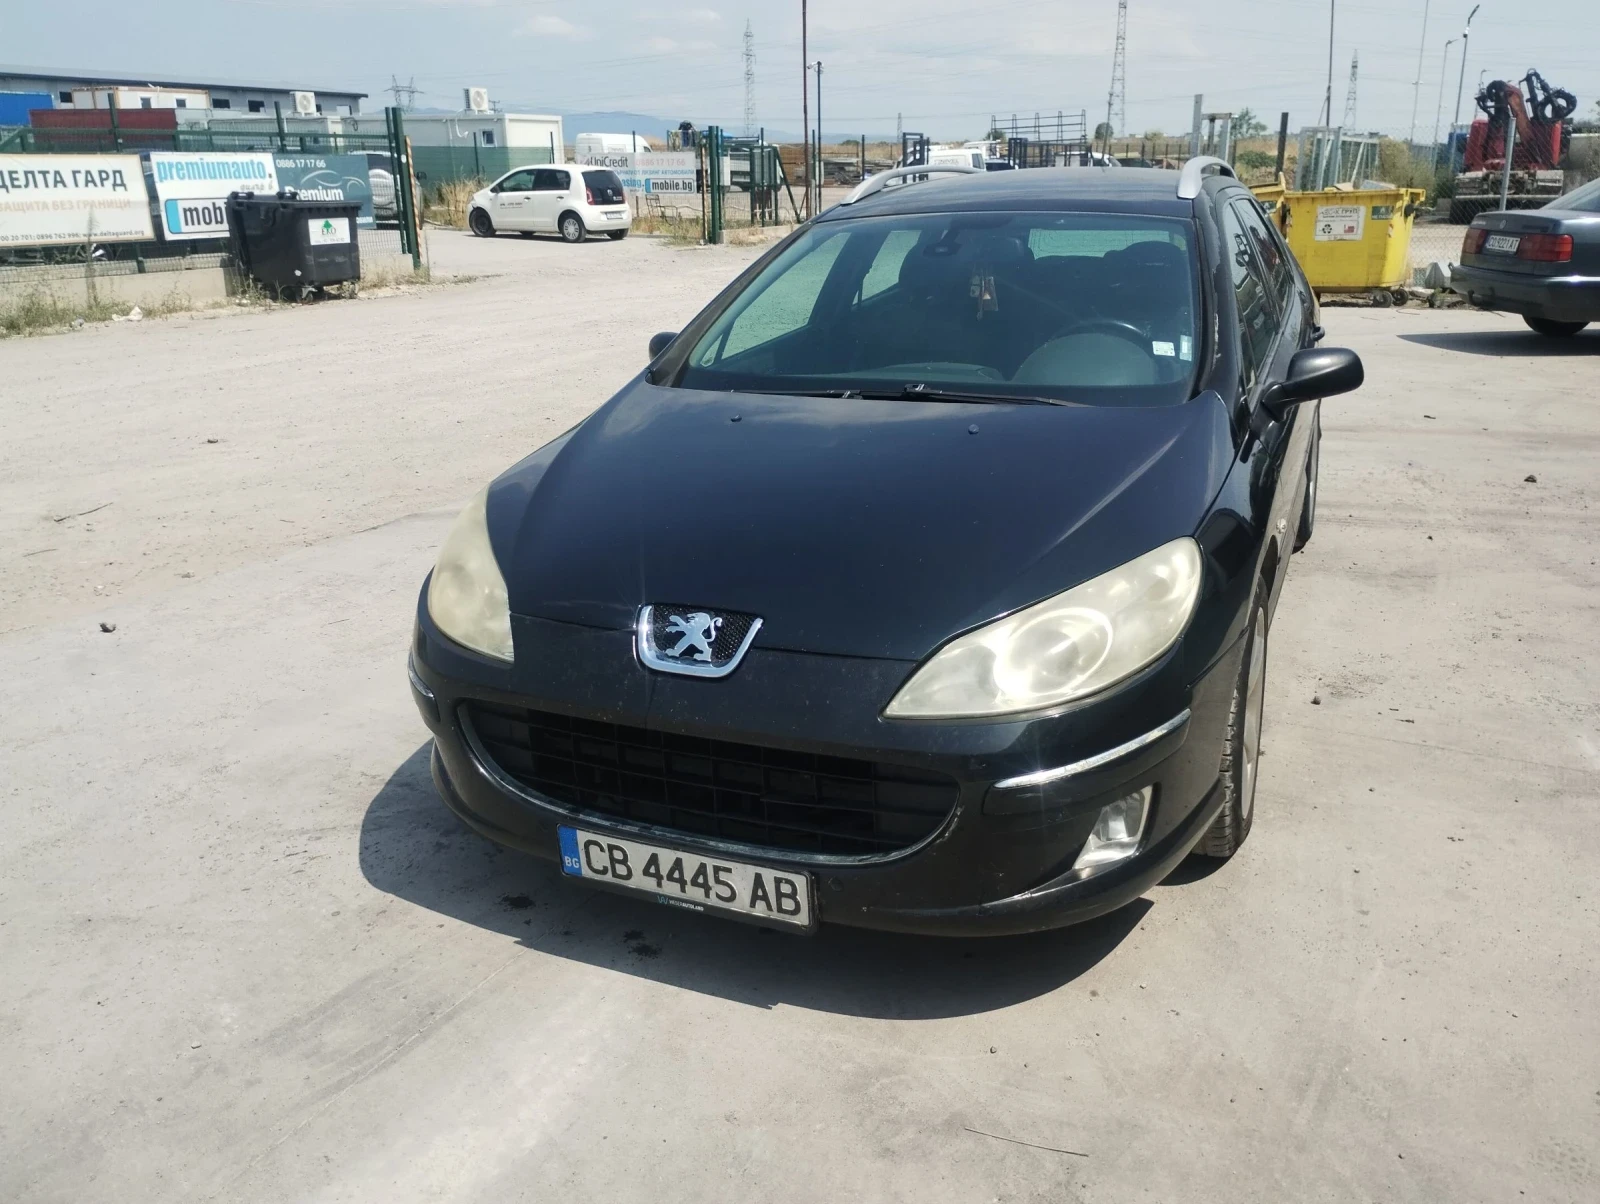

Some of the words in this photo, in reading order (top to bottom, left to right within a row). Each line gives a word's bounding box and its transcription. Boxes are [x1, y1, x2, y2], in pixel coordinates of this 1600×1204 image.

[276, 159, 296, 168] 0886
[296, 159, 305, 168] 17
[306, 159, 315, 168] 17
[316, 159, 326, 168] 66
[591, 155, 629, 168] UniCredit
[71, 169, 128, 192] ГАРД
[652, 180, 692, 192] mobile.bg
[52, 200, 74, 211] БЕЗ
[76, 198, 131, 211] ГРАНИЦИ
[564, 856, 580, 869] BG
[582, 838, 634, 881] CB
[642, 852, 737, 903] 4445
[749, 872, 802, 917] AB
